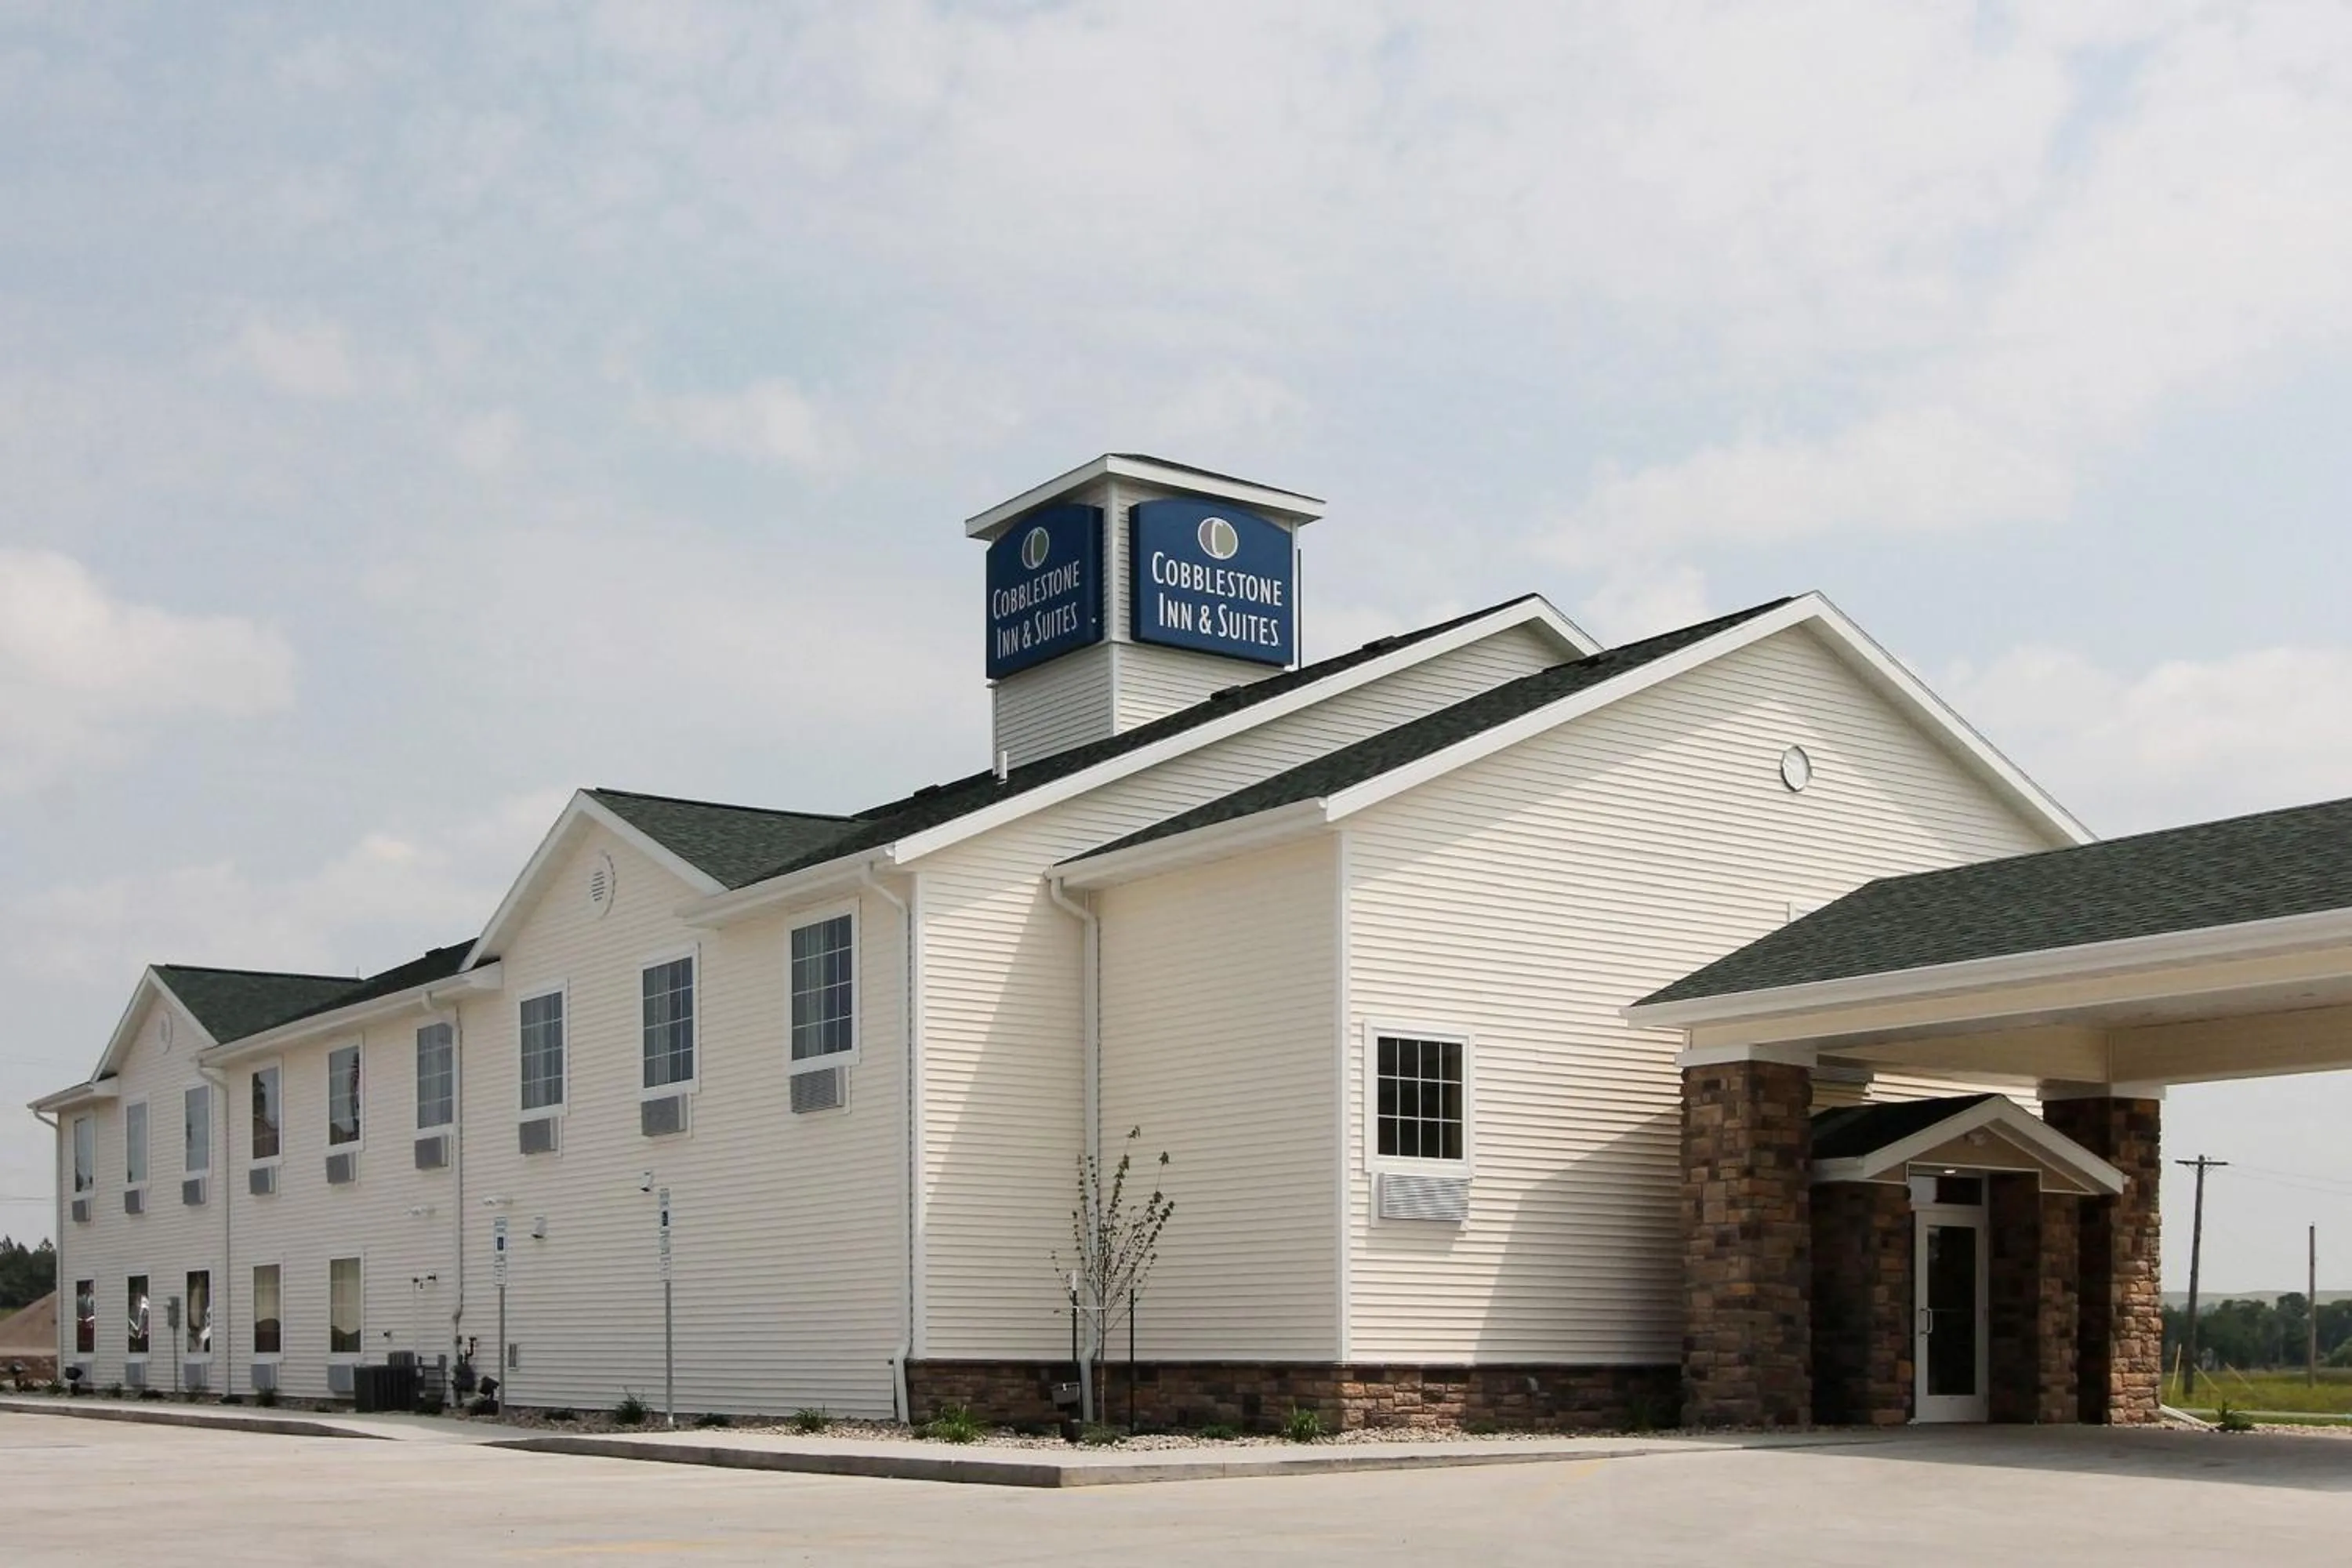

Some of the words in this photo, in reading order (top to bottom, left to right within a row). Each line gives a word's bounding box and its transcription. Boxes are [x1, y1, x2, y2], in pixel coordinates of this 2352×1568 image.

[993, 560, 1080, 620] COBBLESTONE
[1152, 551, 1283, 607] COBBLESTONE
[997, 625, 1018, 659] INN
[1022, 619, 1032, 649] &
[1035, 601, 1079, 645] SUITES
[1159, 593, 1192, 632] INN
[1199, 604, 1212, 635] &
[1218, 603, 1279, 647] SUITES
